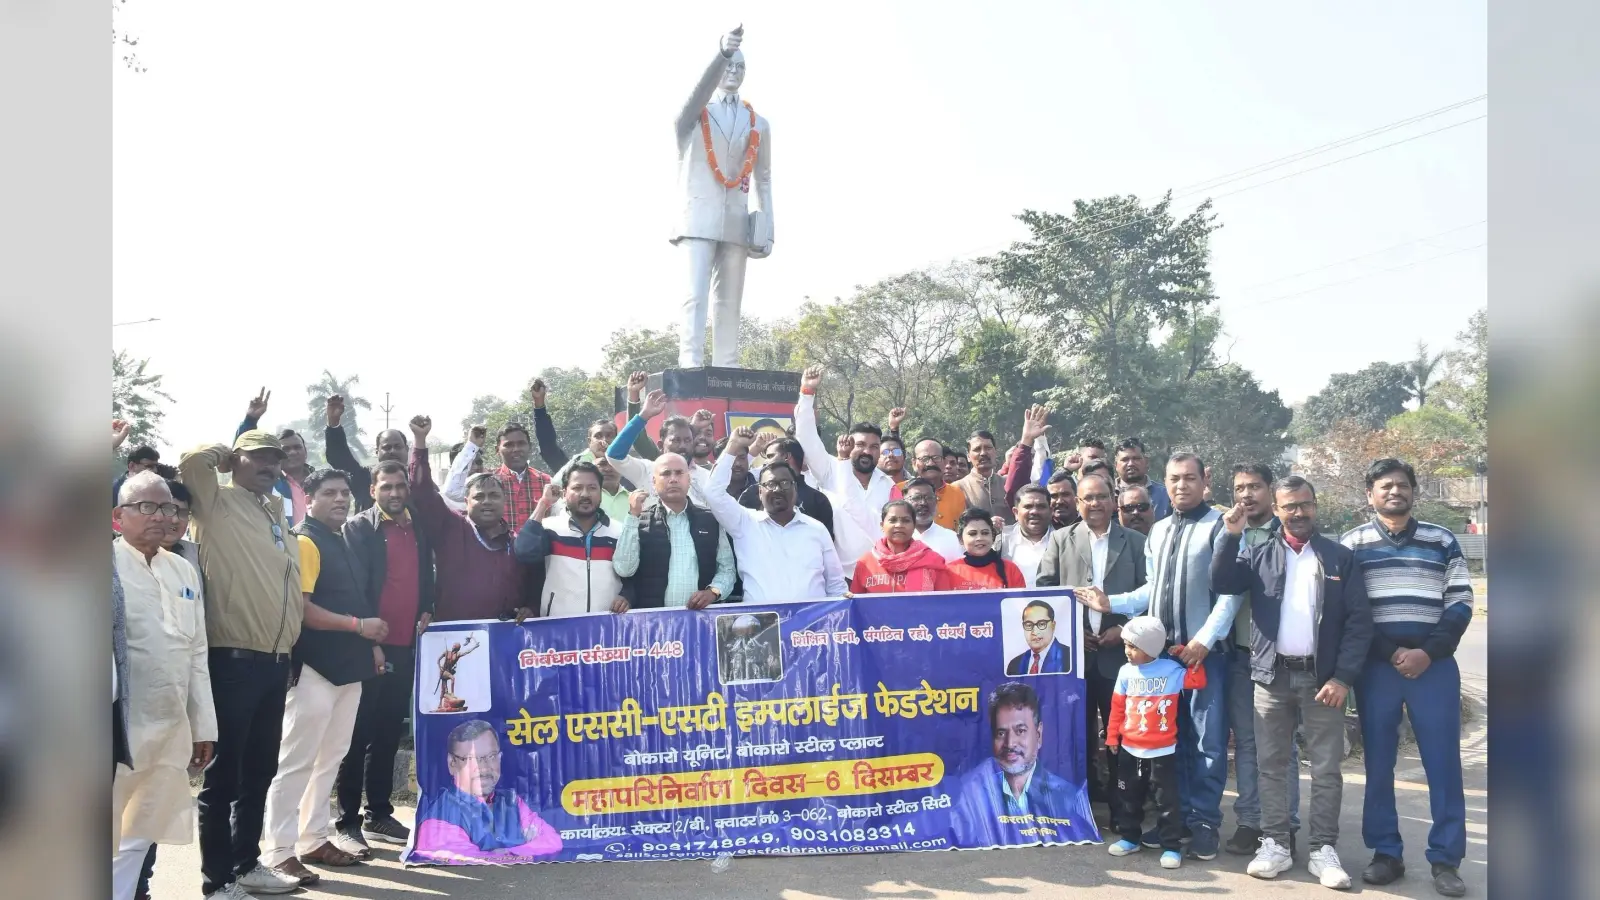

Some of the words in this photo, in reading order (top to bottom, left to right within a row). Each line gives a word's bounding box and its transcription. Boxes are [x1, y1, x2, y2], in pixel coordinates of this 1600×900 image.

[863, 626, 904, 642] संगठित
[908, 624, 933, 642] रहो,
[519, 648, 579, 669] निबंधन
[581, 645, 630, 664] संख्या
[648, 641, 684, 658] 448
[506, 708, 560, 745] सेल
[734, 683, 867, 732] इम्पलाईज
[874, 680, 979, 719] फेडरेशन
[624, 749, 678, 766] बोकारो
[736, 739, 790, 757] बोकारो
[794, 736, 835, 752] स्टील
[839, 735, 884, 751] प्लान्ट
[572, 773, 733, 812] महापरिनिर्वाण
[852, 761, 935, 790] दिसम्बर
[631, 821, 672, 835] सेक्टर
[714, 815, 757, 829] क्वाटर
[837, 803, 883, 819] बोकारो
[886, 799, 919, 815] स्टील
[921, 794, 951, 811] सिटी
[790, 821, 916, 842] 9031083314
